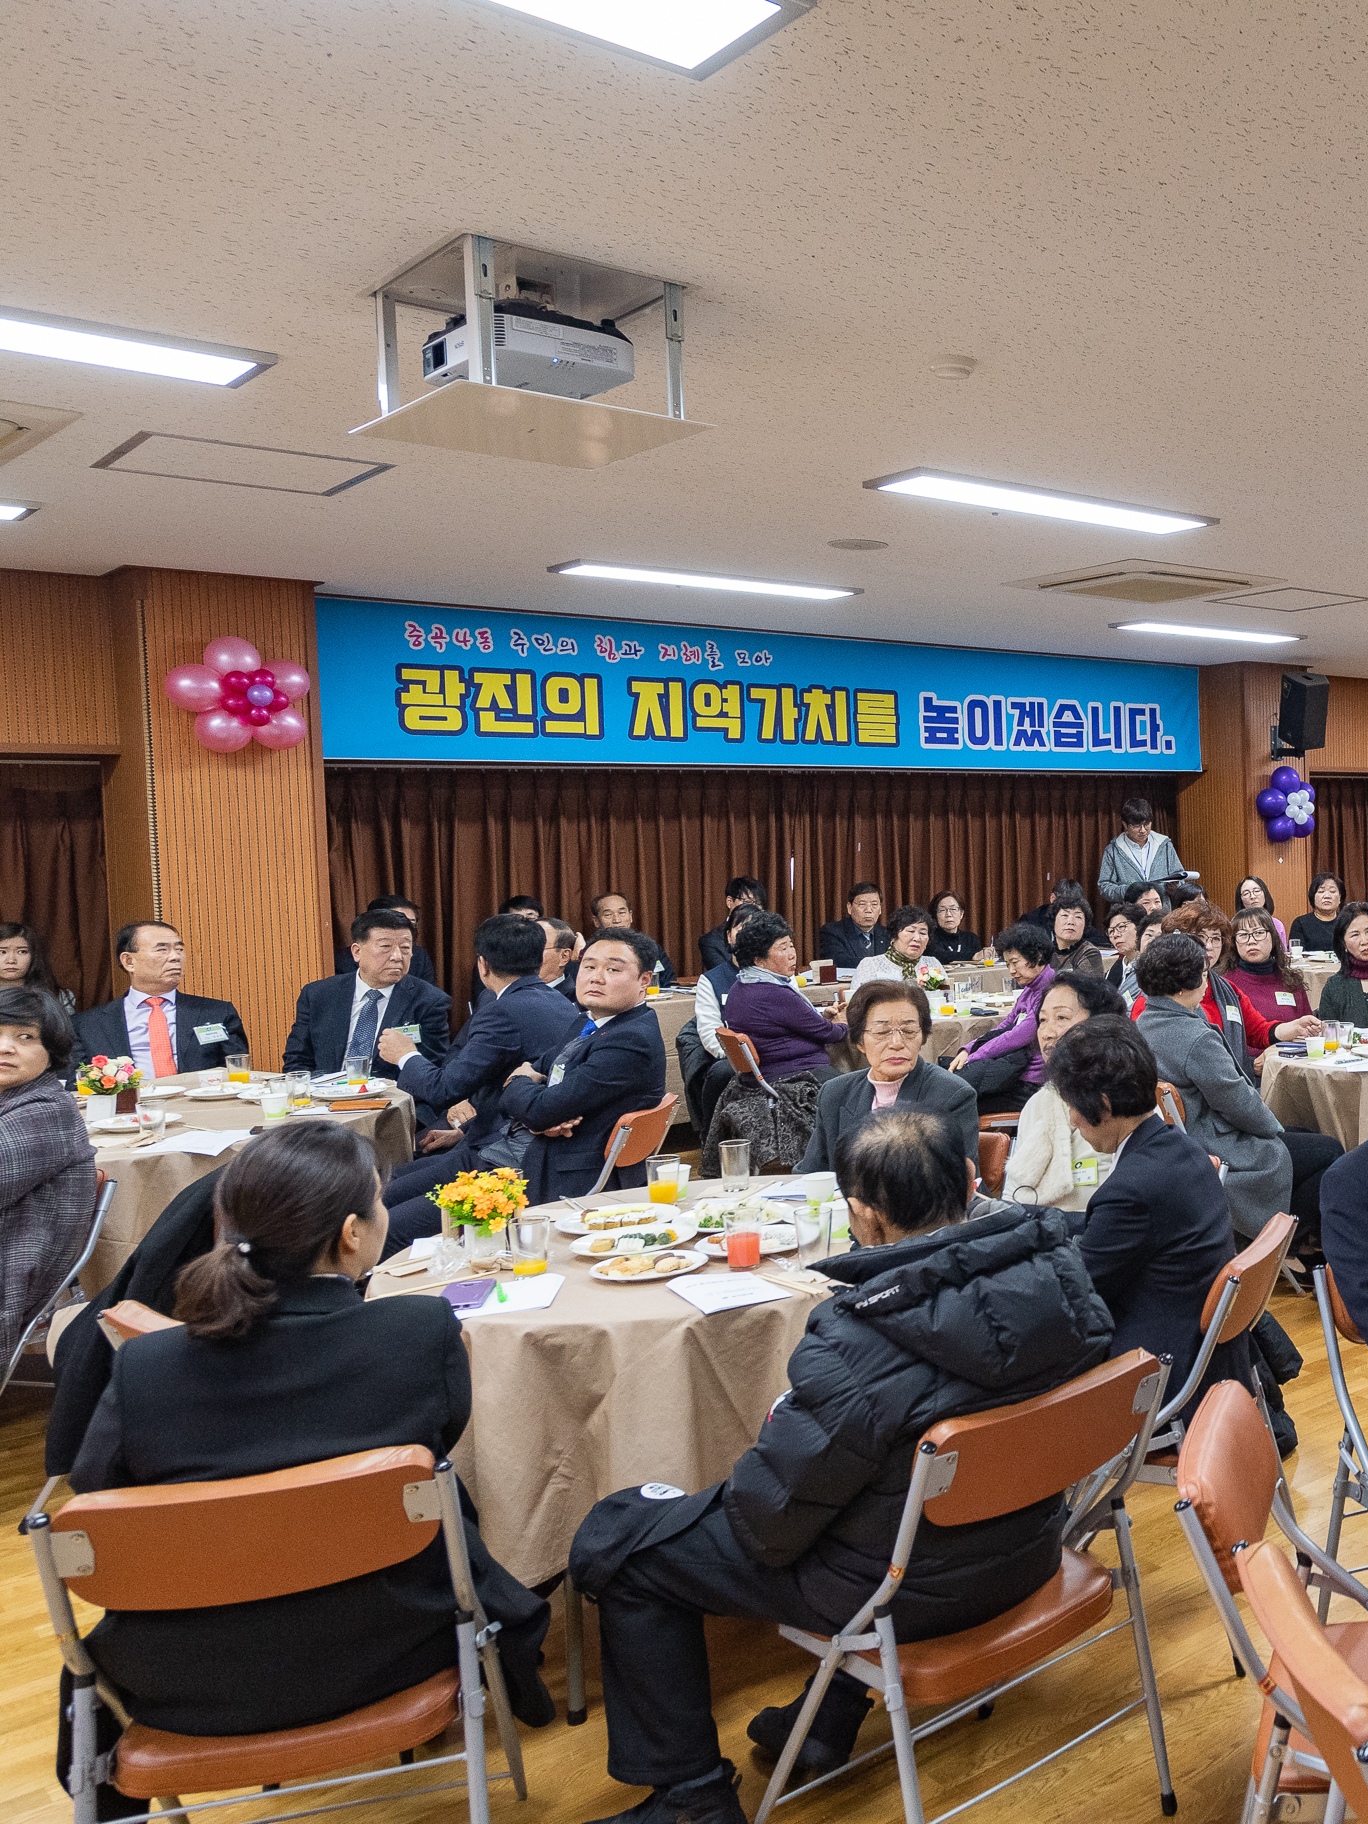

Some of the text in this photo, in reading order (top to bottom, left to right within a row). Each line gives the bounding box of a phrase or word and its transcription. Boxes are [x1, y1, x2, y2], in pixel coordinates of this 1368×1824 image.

[405, 622, 774, 669] 중곡4동 주민의 힘과 지혜를 모아
[398, 666, 1174, 753] 광진의 지역가치를 높이겠습니다.
